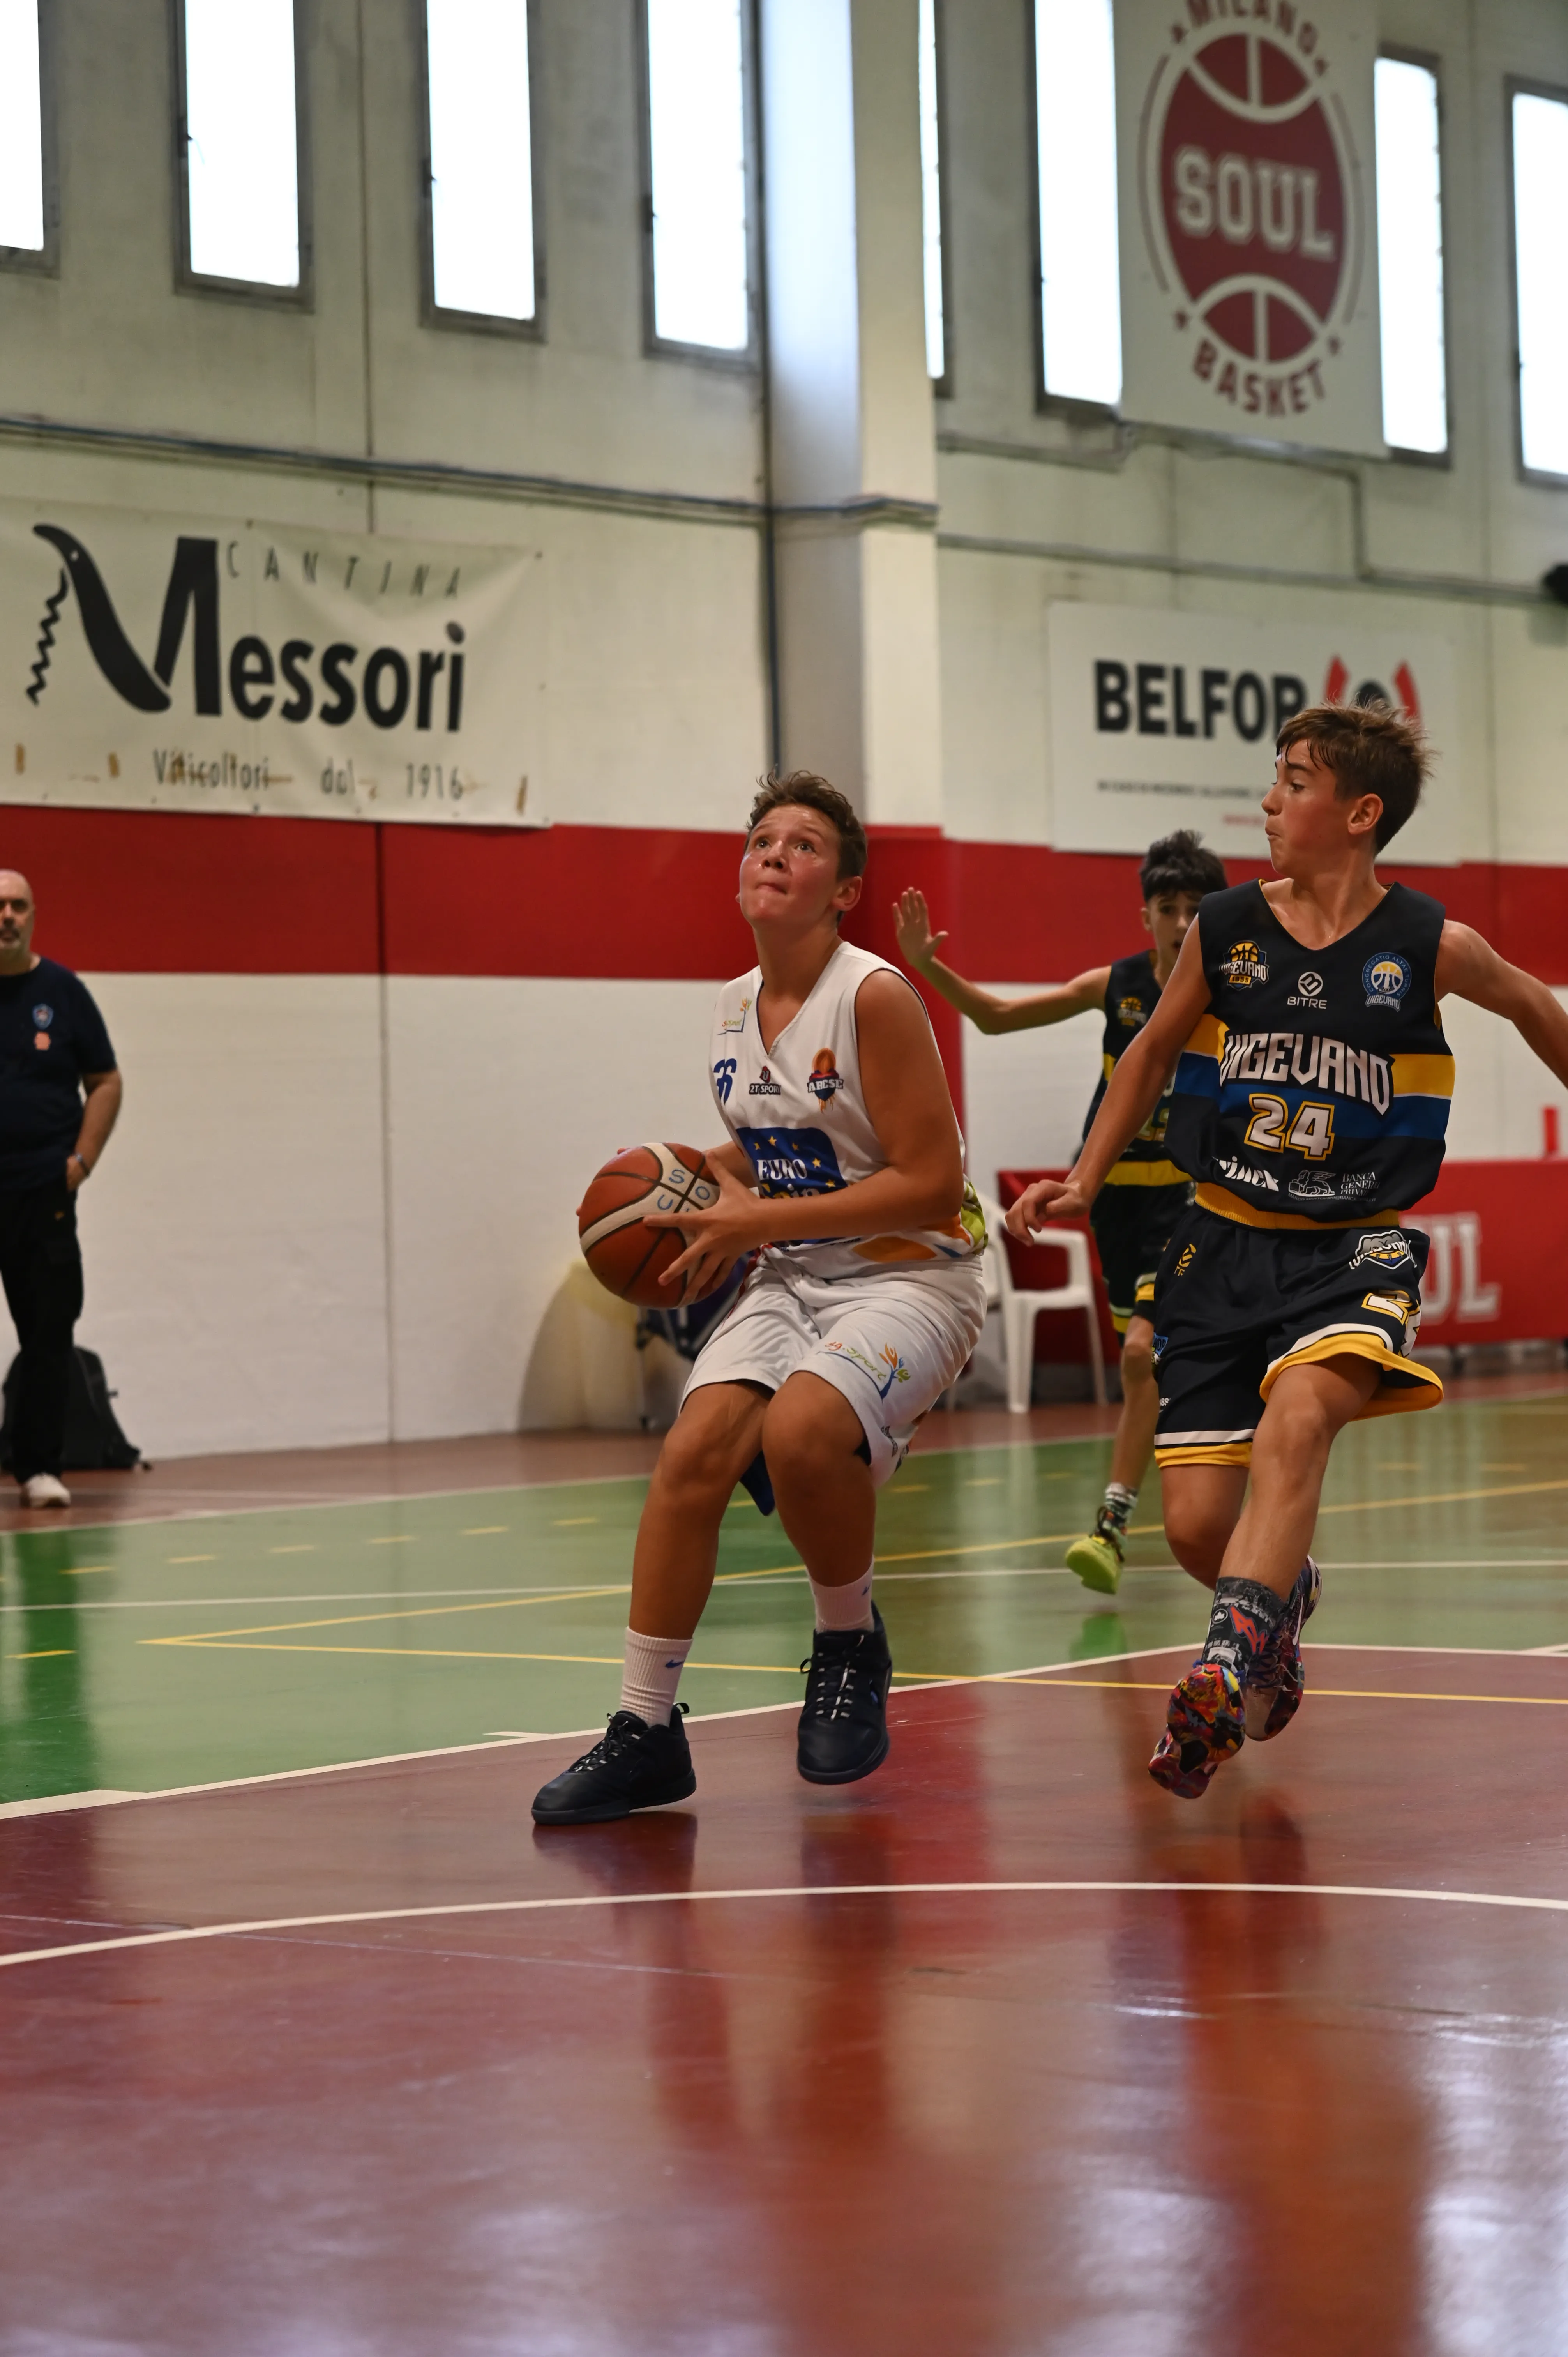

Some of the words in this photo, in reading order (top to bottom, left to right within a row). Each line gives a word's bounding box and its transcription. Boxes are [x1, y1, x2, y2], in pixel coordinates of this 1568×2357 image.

[1174, 148, 1334, 262] SOUL
[1192, 337, 1326, 418] BASKET
[227, 540, 460, 599] CANTINA
[27, 524, 465, 732] Messori
[319, 756, 355, 795] dal
[406, 762, 463, 800] 1916
[1287, 996, 1327, 1009] BITRE
[1244, 1093, 1335, 1160] 24
[757, 1158, 808, 1180] EURO
[1342, 1171, 1376, 1182] BANCA
